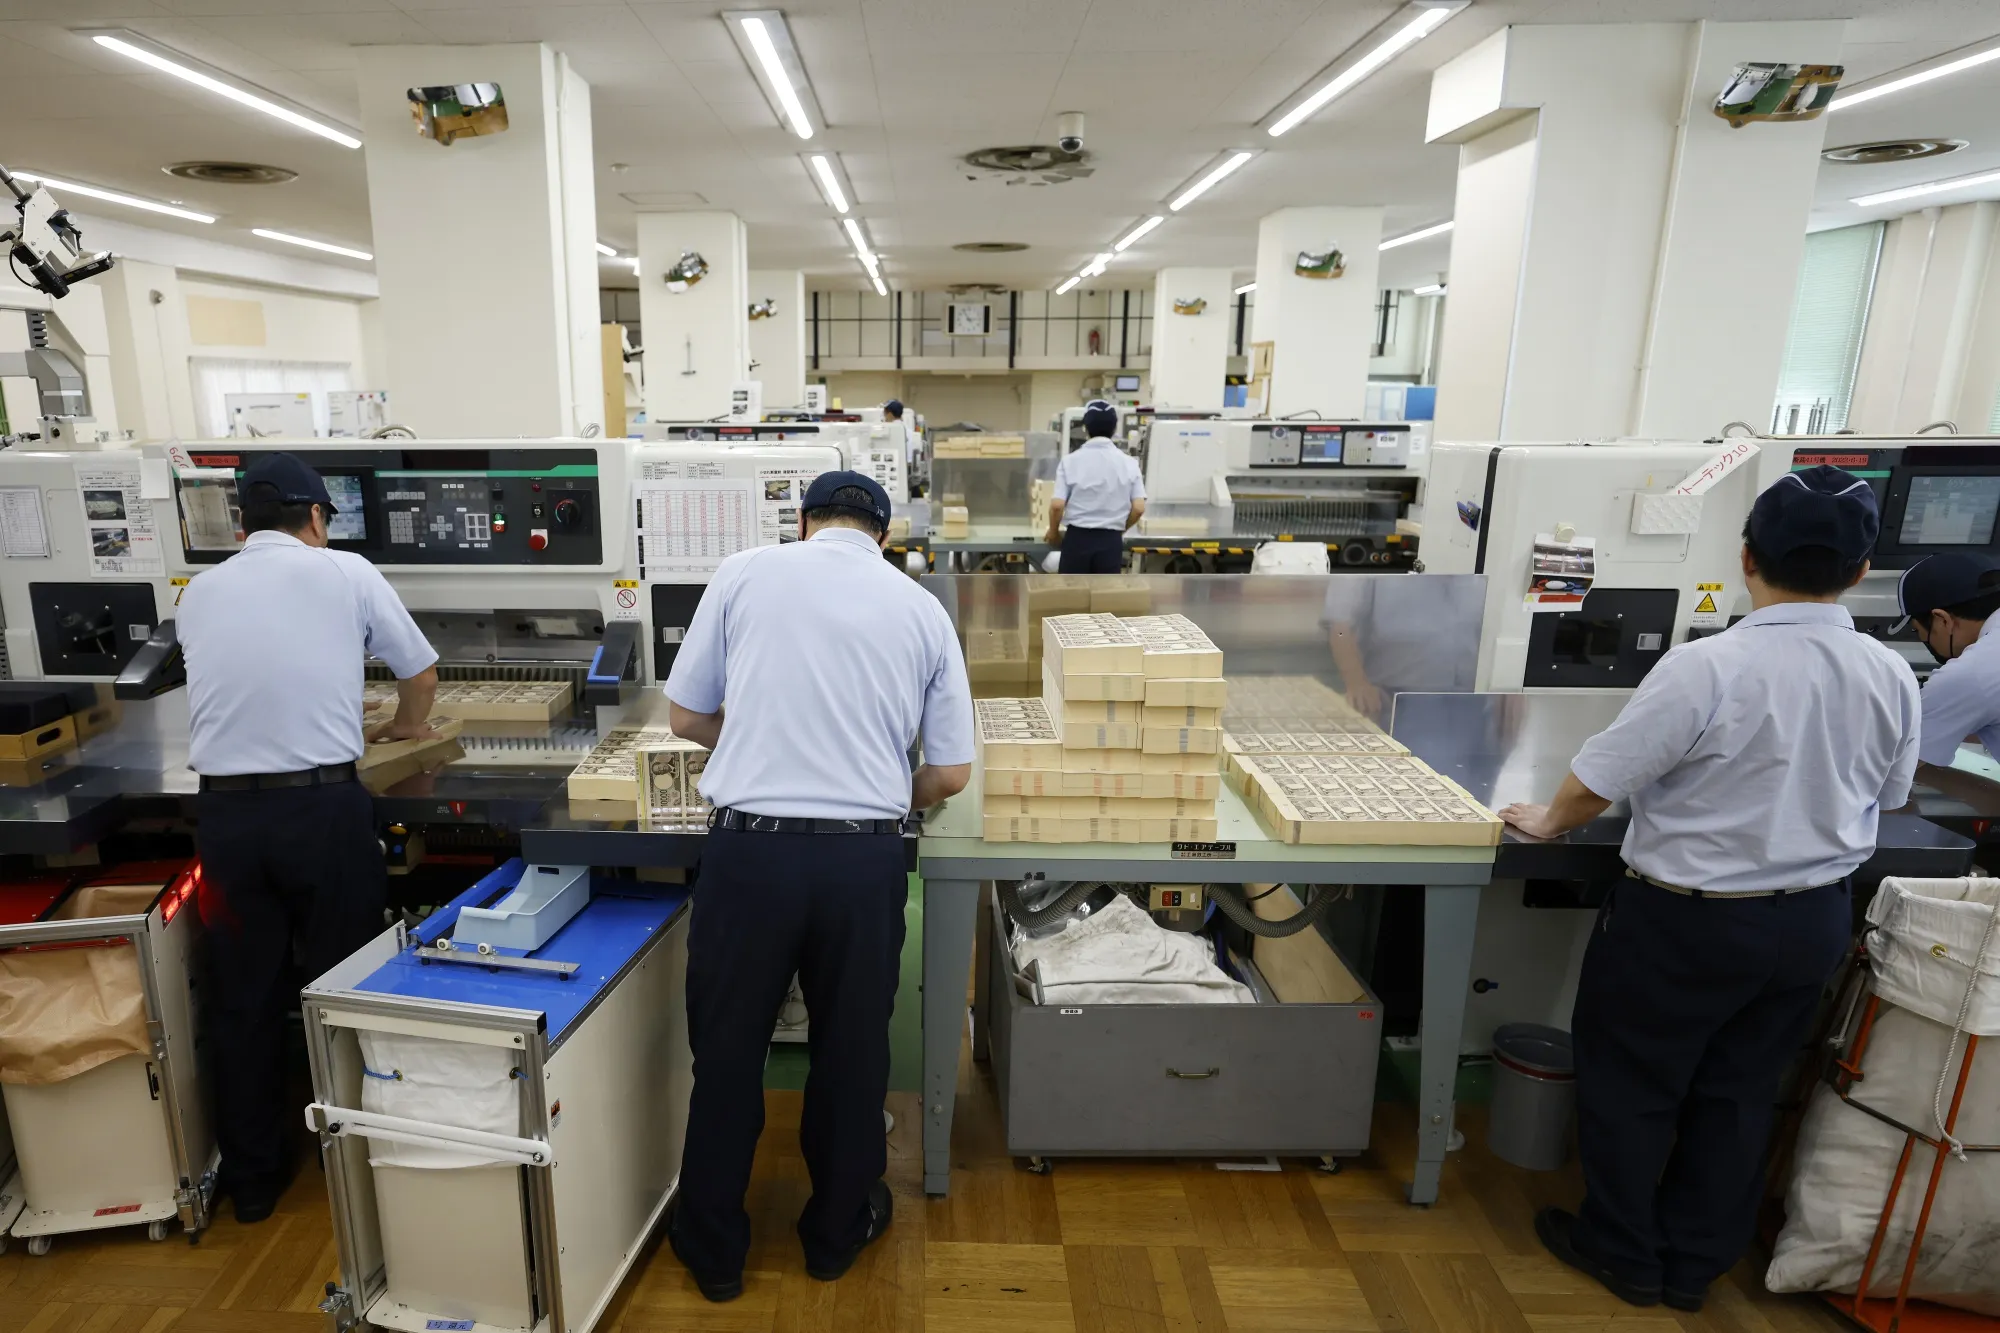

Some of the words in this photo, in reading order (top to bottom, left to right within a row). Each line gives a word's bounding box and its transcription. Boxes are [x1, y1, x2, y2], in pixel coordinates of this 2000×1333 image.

[1678, 444, 1748, 495] トーテック10
